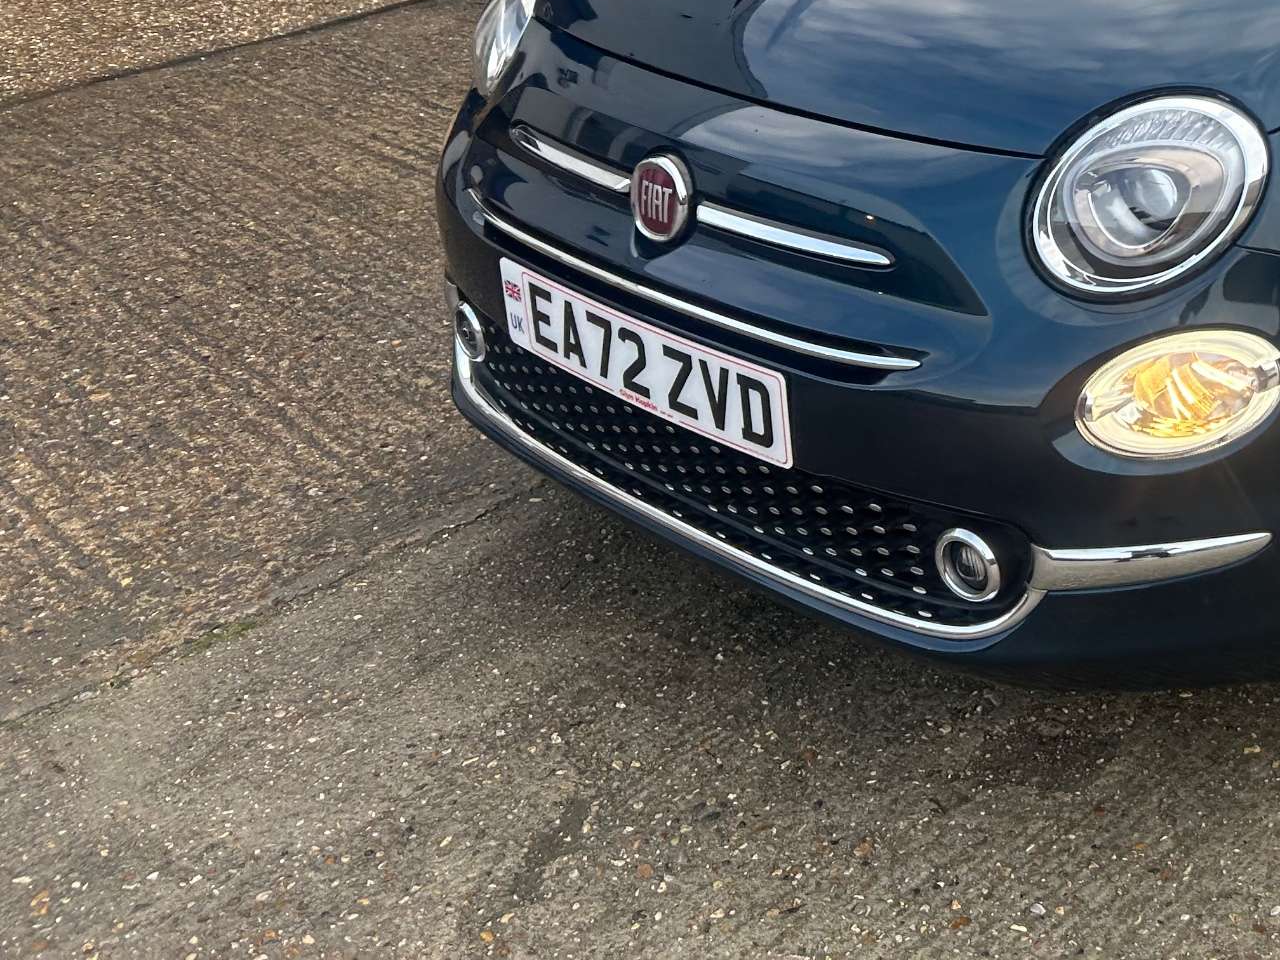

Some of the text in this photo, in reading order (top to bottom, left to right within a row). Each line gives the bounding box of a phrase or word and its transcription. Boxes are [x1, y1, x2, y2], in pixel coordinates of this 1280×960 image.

[641, 179, 673, 224] FIAT
[510, 312, 525, 334] UK
[527, 281, 774, 449] EA72 ZVD
